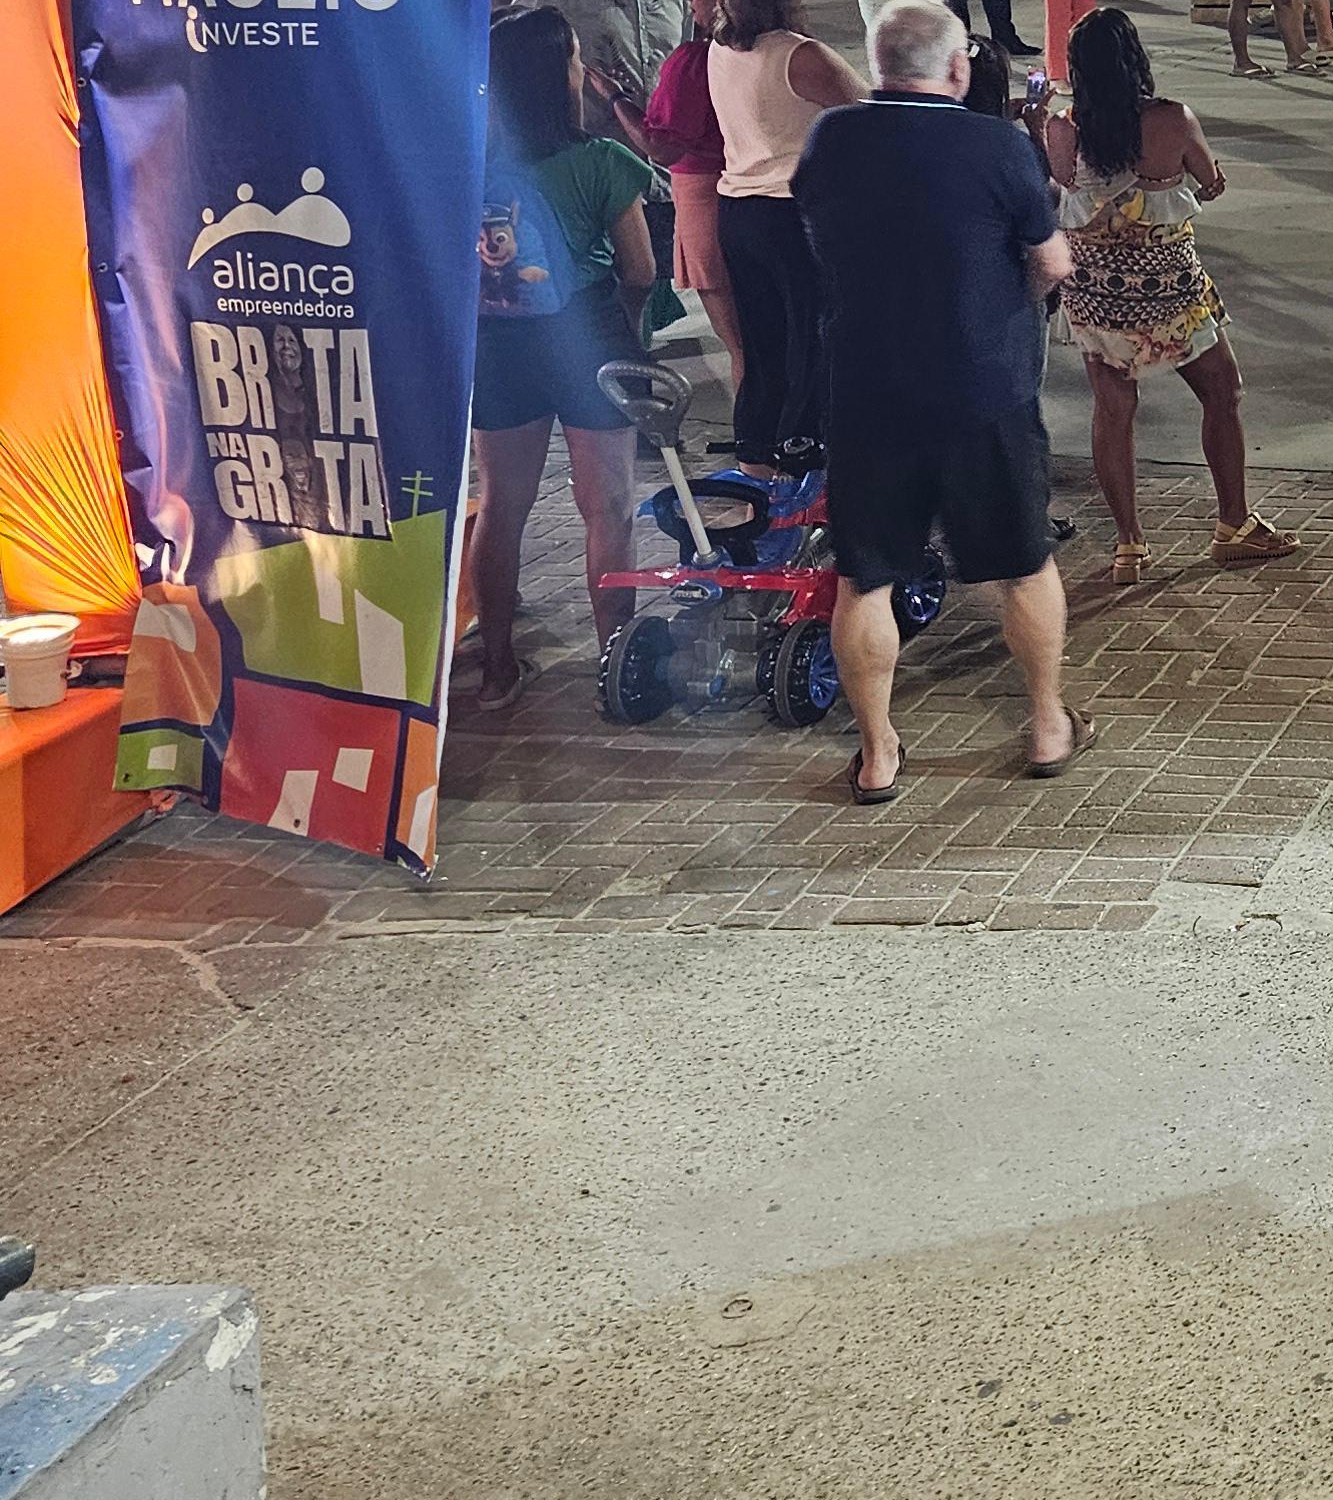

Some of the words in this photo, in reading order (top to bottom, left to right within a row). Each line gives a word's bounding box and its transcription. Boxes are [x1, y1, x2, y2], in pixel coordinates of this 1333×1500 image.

[212, 251, 355, 299] aliança
[217, 297, 355, 319] empreendedora
[207, 432, 249, 460] NA
